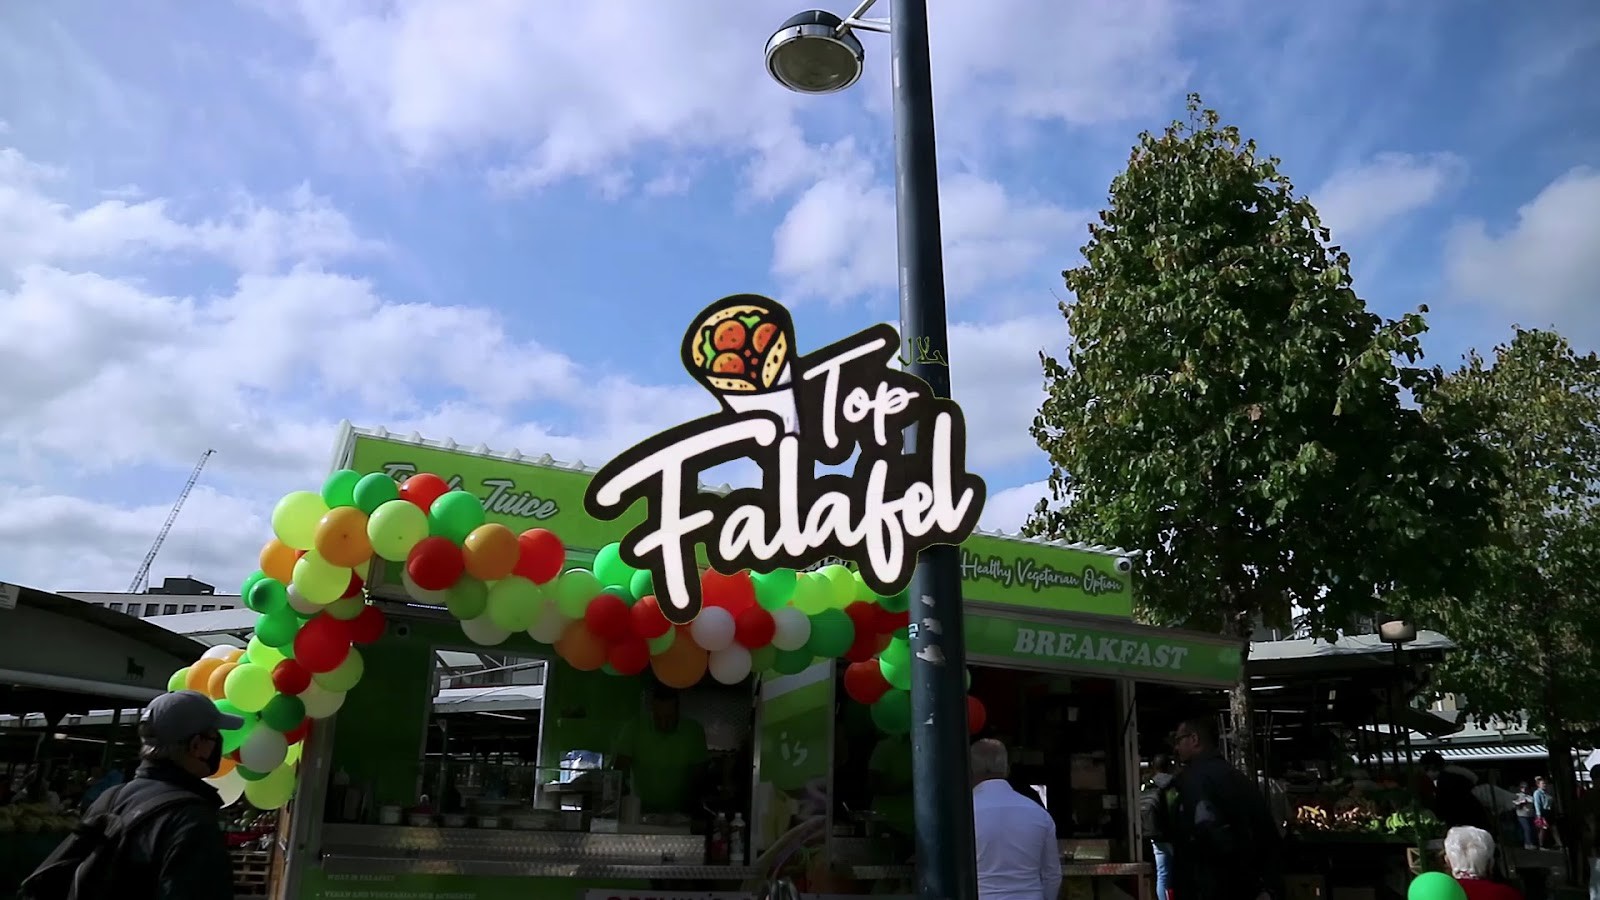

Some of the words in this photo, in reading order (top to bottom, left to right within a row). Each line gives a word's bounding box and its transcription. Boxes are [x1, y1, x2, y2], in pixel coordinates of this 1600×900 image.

[482, 479, 559, 520] Juice
[960, 551, 1011, 585] Healthy
[1017, 561, 1080, 590] Vegetarian
[1083, 568, 1122, 593] Option
[1013, 627, 1188, 670] BREAKFAST
